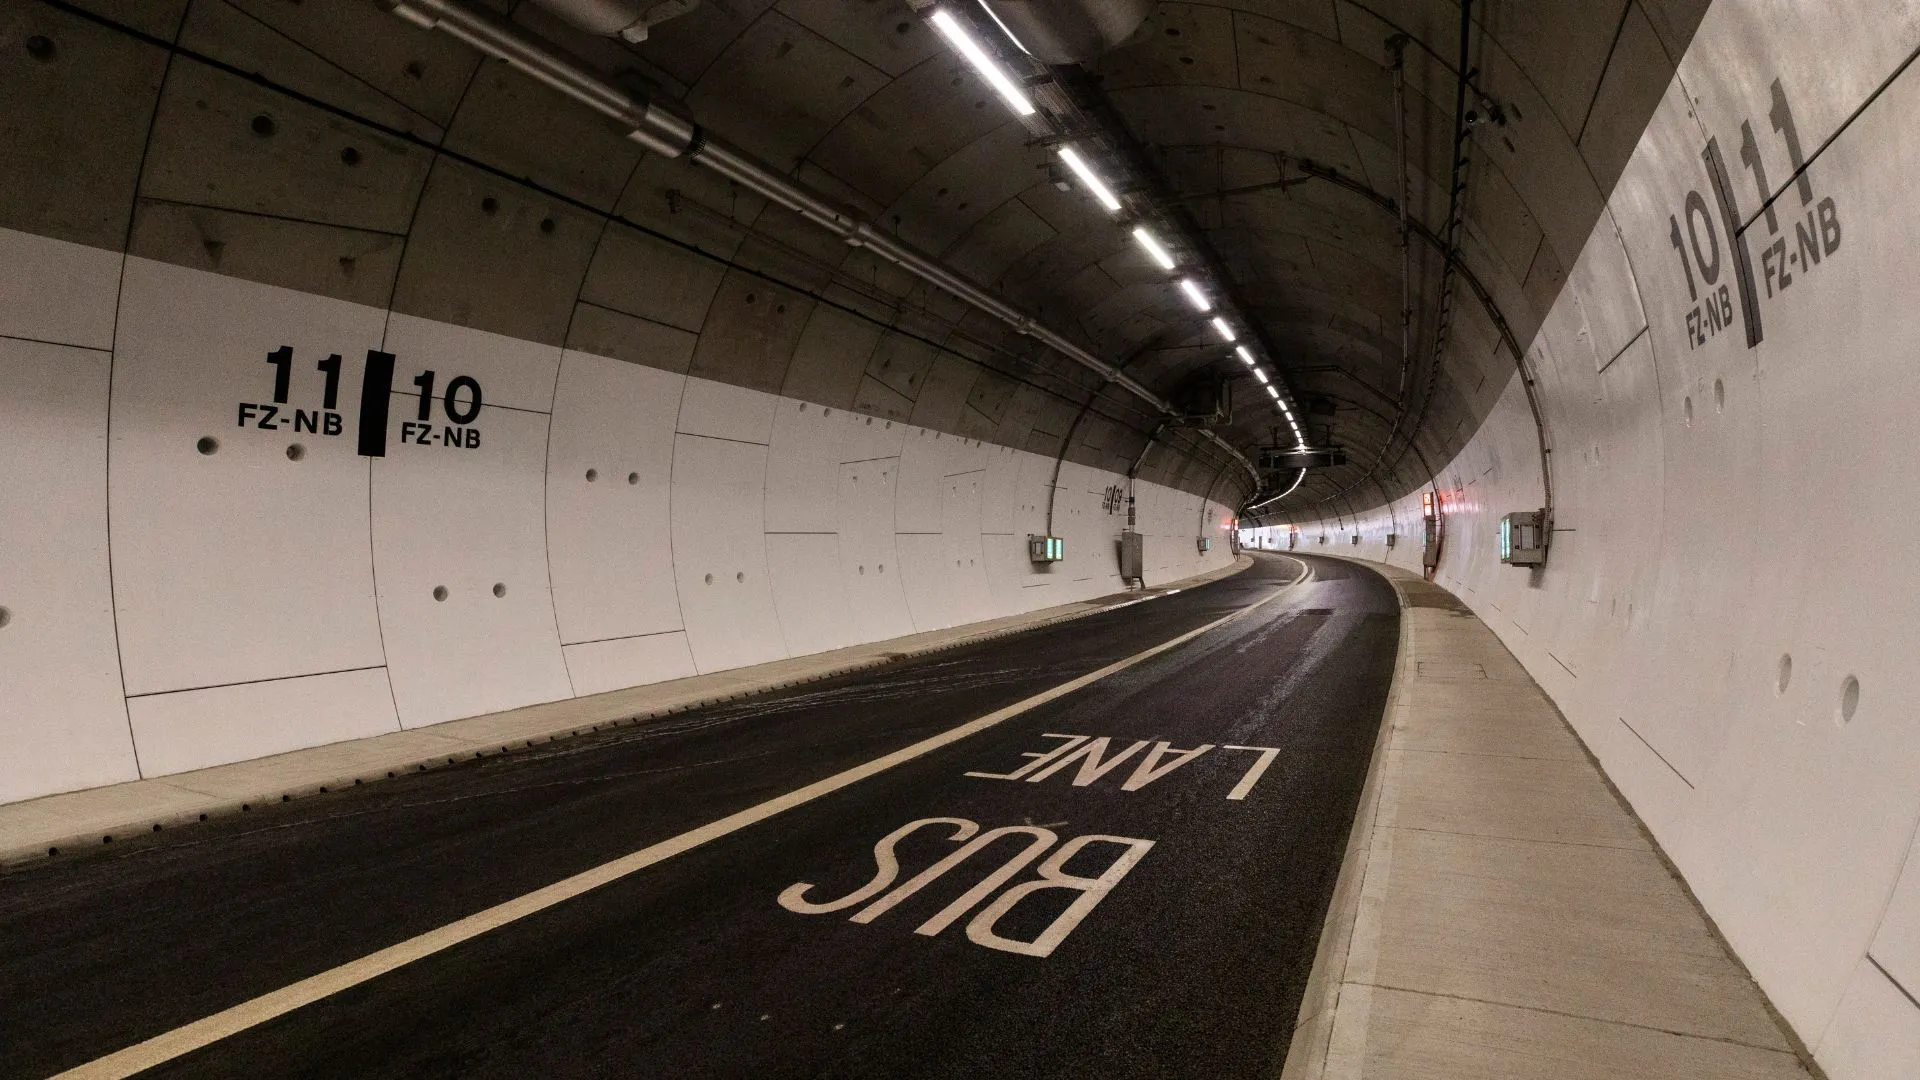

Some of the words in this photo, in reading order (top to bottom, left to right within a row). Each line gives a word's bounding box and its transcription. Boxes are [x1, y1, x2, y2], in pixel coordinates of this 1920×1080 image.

[1740, 77, 1813, 236] 11
[1669, 190, 1720, 303] 10
[1761, 196, 1842, 300] FZ-NB
[1685, 284, 1733, 351] FZ-NB
[266, 345, 342, 410] 11
[414, 370, 482, 425] 10
[238, 402, 343, 436] FZ-NB
[401, 422, 481, 449] FZ-NB
[963, 733, 1281, 800] LANE
[777, 817, 1157, 958] BUS
